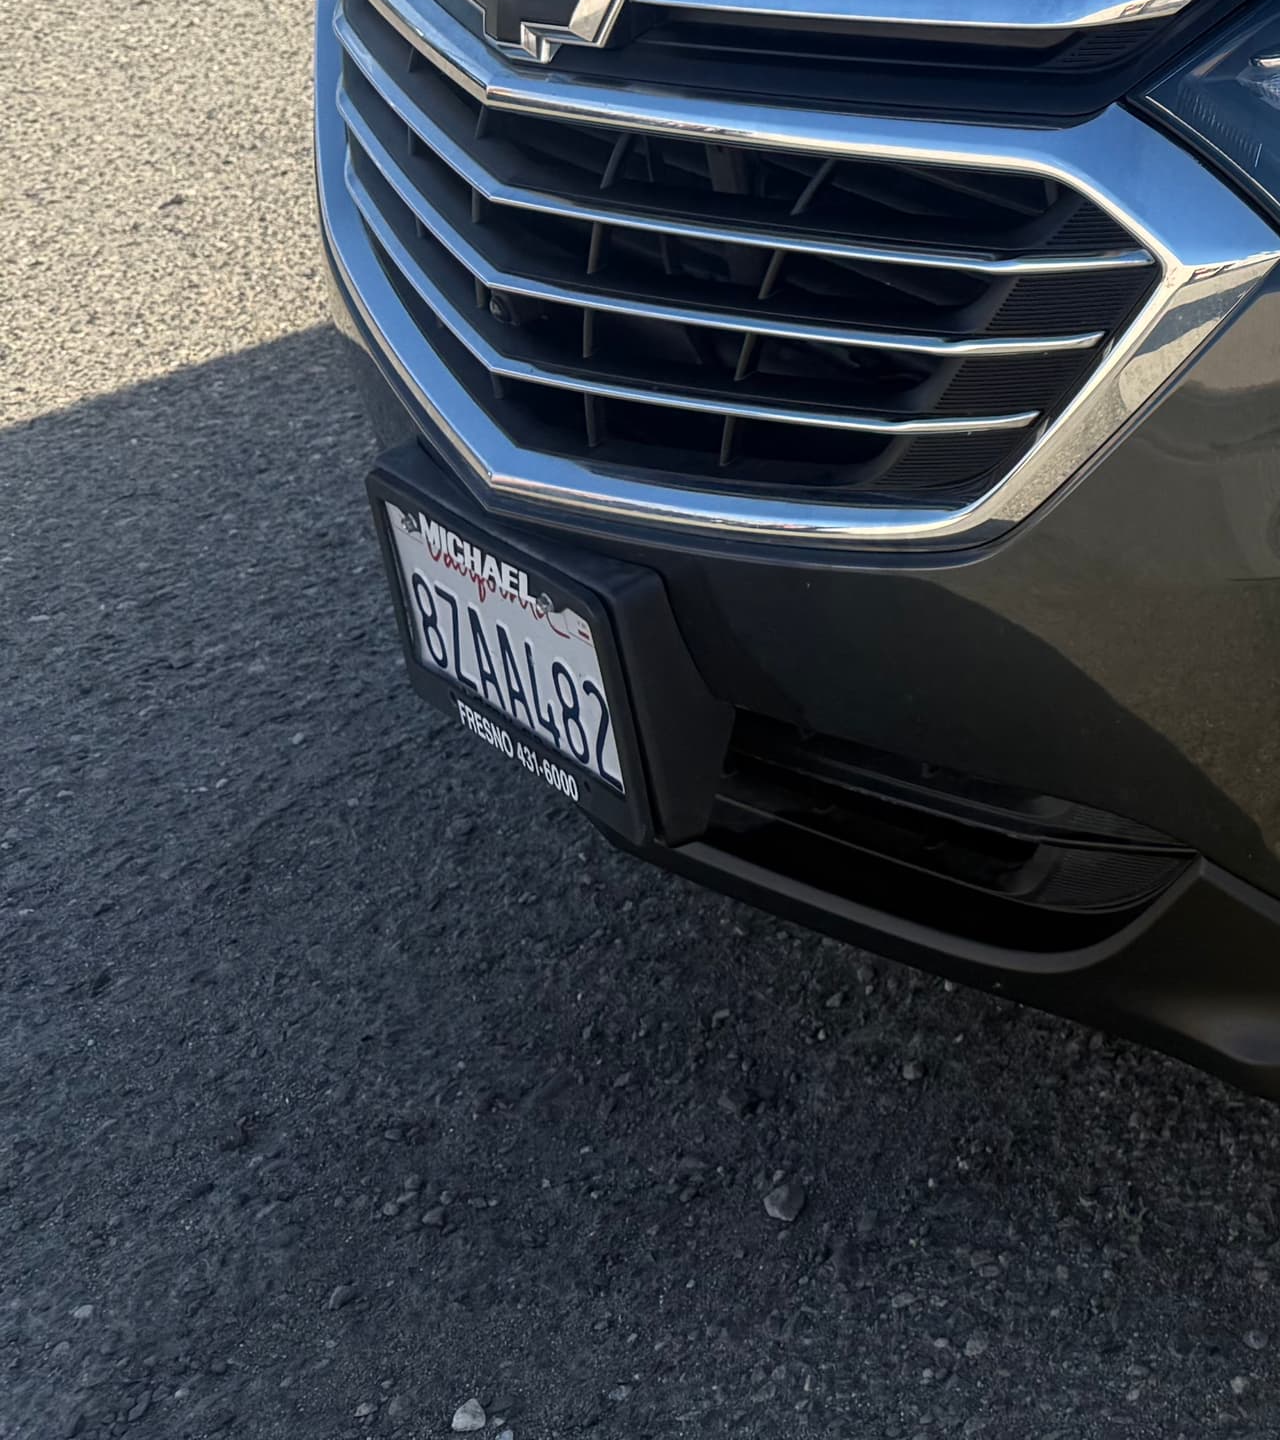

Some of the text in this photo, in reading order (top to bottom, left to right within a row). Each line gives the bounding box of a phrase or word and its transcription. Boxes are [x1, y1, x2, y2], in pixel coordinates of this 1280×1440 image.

[418, 512, 537, 604] MICHAEL
[411, 569, 624, 792] 8ZAA482
[457, 701, 579, 803] FRESNO 431-6000
